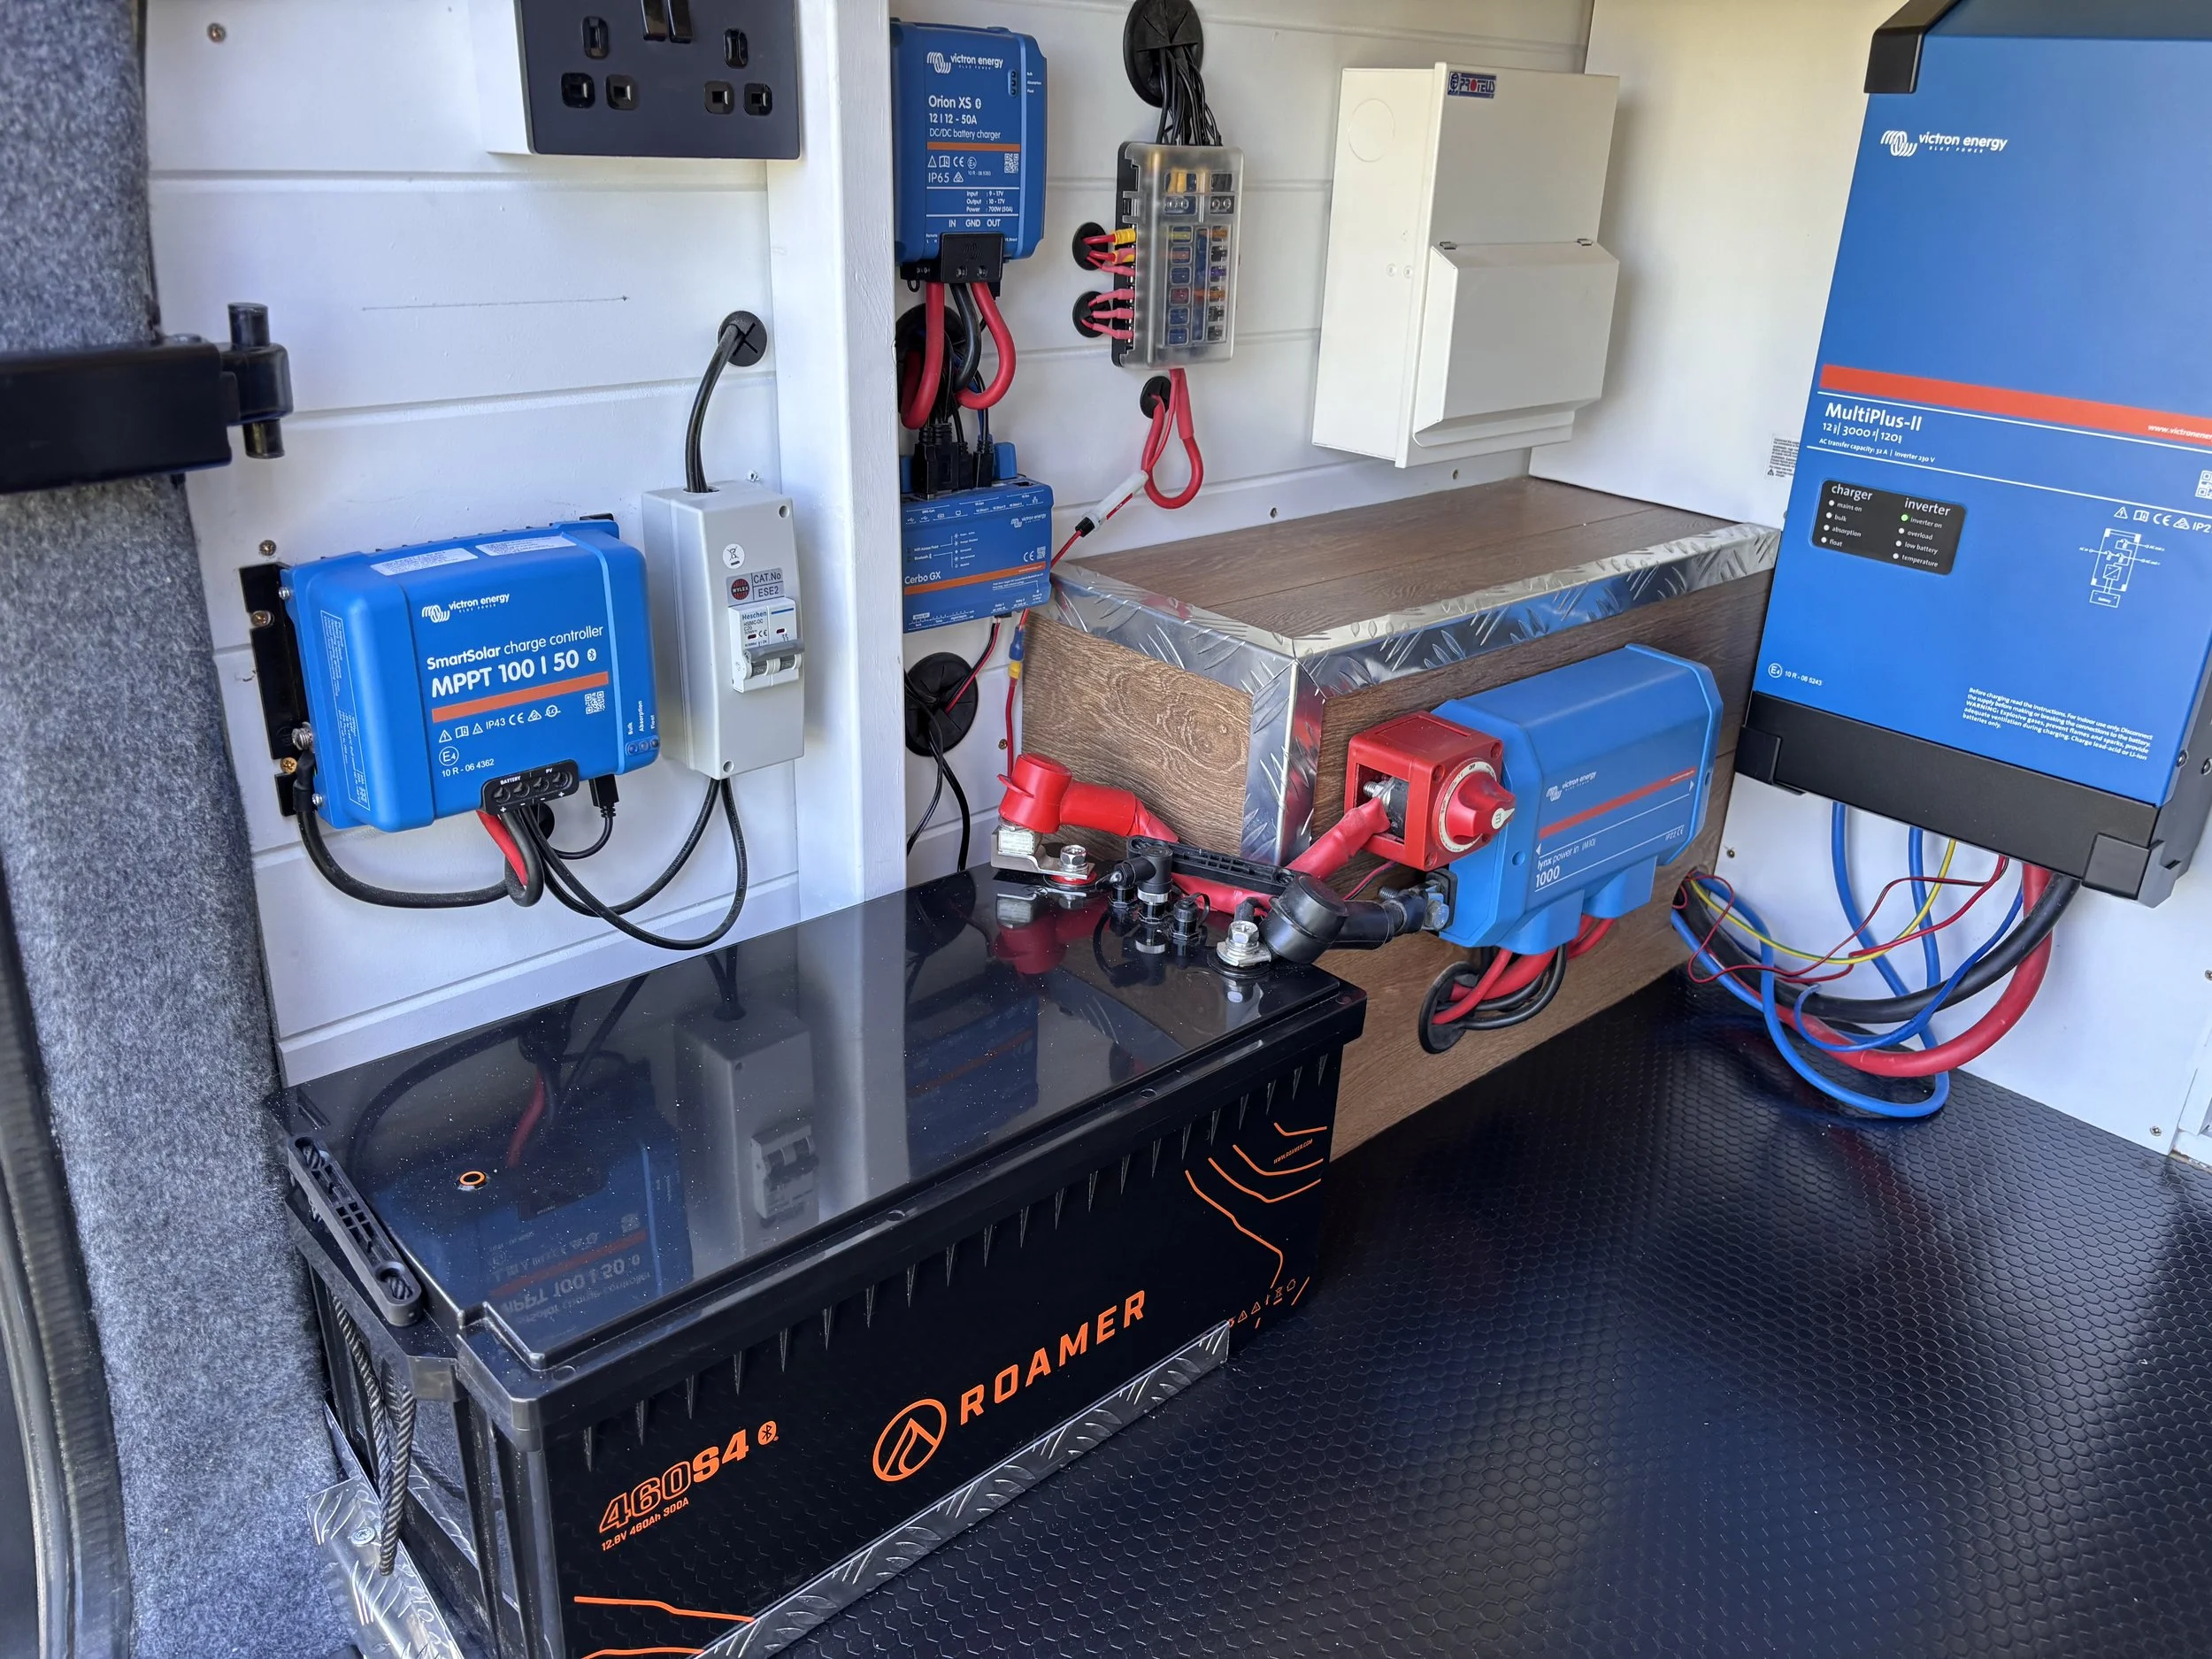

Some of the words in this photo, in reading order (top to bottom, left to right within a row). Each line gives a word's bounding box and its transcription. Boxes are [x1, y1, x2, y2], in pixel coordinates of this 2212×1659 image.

[950, 53, 976, 65] victron
[978, 58, 1003, 69] energy
[928, 95, 956, 108] Orion
[958, 96, 972, 110] XS
[929, 113, 938, 124] 12
[945, 113, 954, 124] 12
[961, 114, 978, 125] 50A
[929, 128, 952, 137] DC/DC
[953, 128, 975, 140] battery
[976, 130, 1001, 141] charger
[1918, 132, 1960, 146] victron
[1962, 135, 2008, 151] energy
[928, 173, 949, 183] IP65
[949, 219, 956, 228] IN
[1824, 402, 1923, 432] MultiPlus-II
[1823, 422, 1832, 432] 12
[1841, 426, 1870, 437] 3000
[1880, 432, 1898, 442] 120
[1827, 439, 1850, 449] transfer
[1850, 443, 1876, 455] capacity:
[1894, 450, 1918, 461] Inverter
[1831, 484, 1874, 502] charger
[1904, 497, 1951, 517] inverter
[1837, 502, 1854, 511] mains
[1909, 517, 1933, 528] inverter
[2192, 521, 2212, 534] IP2
[1832, 526, 1862, 538] absorption
[1907, 530, 1933, 541] overload
[1829, 538, 1843, 547] float
[1904, 541, 1916, 550] low
[1916, 542, 1939, 556] battery
[1901, 554, 1939, 568] temperature
[753, 572, 781, 584] CAT.No
[904, 573, 928, 584] Cerbo
[929, 571, 941, 580] GX
[758, 586, 779, 597] ESE2
[449, 598, 478, 611] victron
[480, 593, 510, 606] energy
[741, 611, 767, 620] Heschen
[427, 646, 501, 671] SmartSolar
[503, 638, 547, 655] charge
[549, 626, 604, 645] controller
[432, 666, 492, 698] MPPT
[498, 658, 535, 683] 100
[553, 649, 580, 672] 50
[1962, 712, 1987, 725] batteries
[1969, 687, 1986, 696] Before
[1986, 692, 2010, 704] charging
[2077, 715, 2096, 725] indoor
[2121, 727, 2153, 741] Disconnect
[1977, 697, 1995, 707] supply
[1994, 700, 2012, 710] before
[2012, 706, 2033, 717] making
[2040, 712, 2065, 726] breaking
[2076, 721, 2109, 736] connections
[2117, 733, 2128, 741] the
[486, 718, 506, 730] IP43
[1963, 707, 1991, 718] adequate
[1991, 714, 2023, 727] ventilation
[2022, 723, 2042, 733] during
[2070, 734, 2093, 747] Charge
[2093, 741, 2122, 754] lead-acid
[2000, 710, 2027, 721] Explosive
[2045, 722, 2069, 733] prevent
[2069, 727, 2090, 738] flames
[2124, 743, 2149, 754] provide
[442, 768, 451, 777] 10
[476, 758, 495, 771] 4362
[1562, 778, 1579, 789] victron
[1579, 772, 1597, 782] energy
[1537, 857, 1552, 872] lynx
[1553, 849, 1572, 865] power
[1573, 844, 1579, 854] in
[1535, 865, 1561, 888] 1000
[960, 1290, 1145, 1425] ROAMER
[599, 1429, 749, 1533] 460S4
[602, 1531, 627, 1551] 12.8V
[630, 1513, 661, 1535] 460Ah
[664, 1497, 689, 1517] 300A
